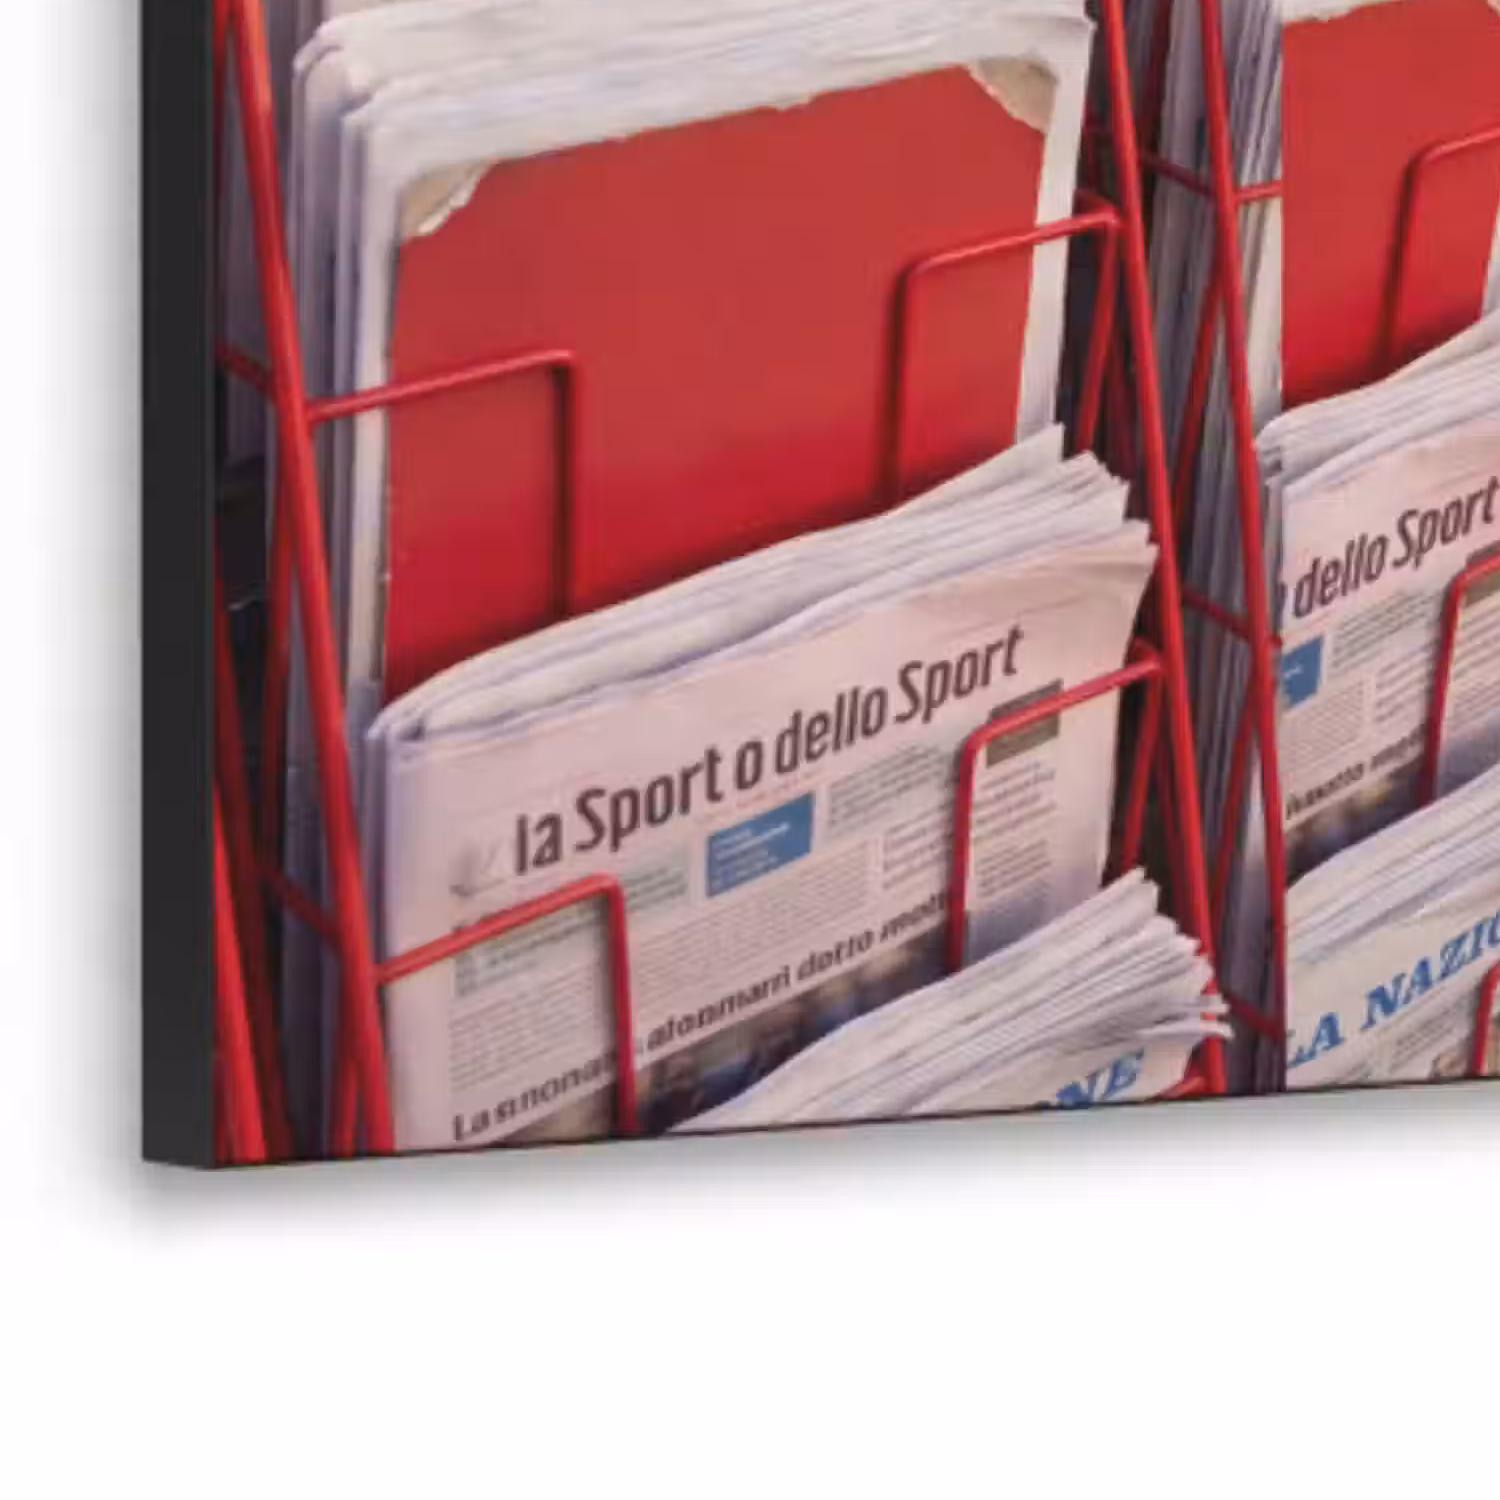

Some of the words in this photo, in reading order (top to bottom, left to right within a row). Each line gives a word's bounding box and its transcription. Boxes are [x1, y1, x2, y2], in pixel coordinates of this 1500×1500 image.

[1293, 532, 1390, 619] dello
[1392, 476, 1500, 568] Sport
[575, 745, 725, 853] Sport
[734, 739, 765, 790] o
[774, 686, 888, 775] dello
[894, 624, 1025, 725] Sport
